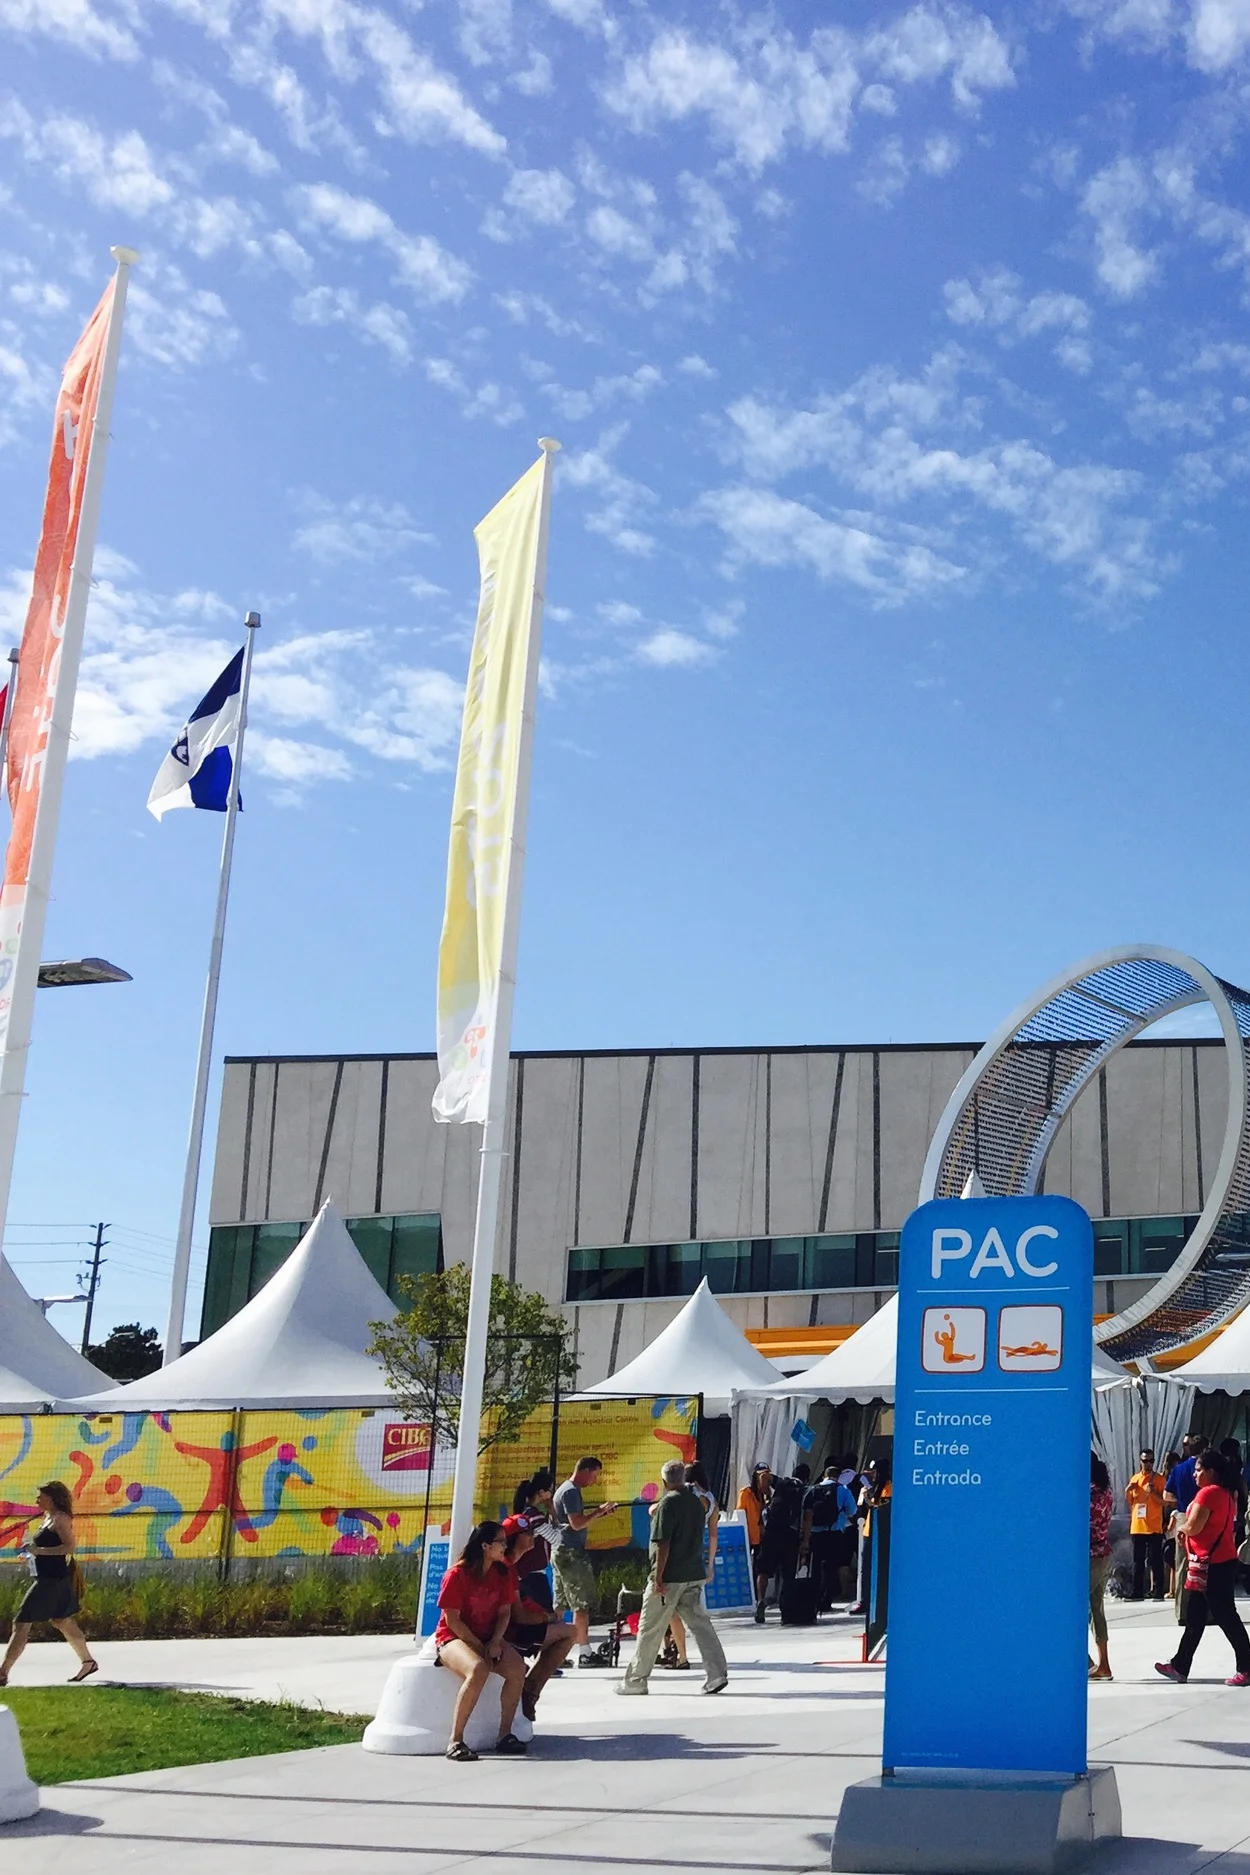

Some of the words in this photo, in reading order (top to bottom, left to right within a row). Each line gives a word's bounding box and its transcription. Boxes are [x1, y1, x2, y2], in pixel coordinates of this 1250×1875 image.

[931, 1225, 1059, 1279] PAC
[914, 1410, 992, 1426] Entrance
[913, 1439, 970, 1456] Entrée
[912, 1469, 982, 1486] Entrada
